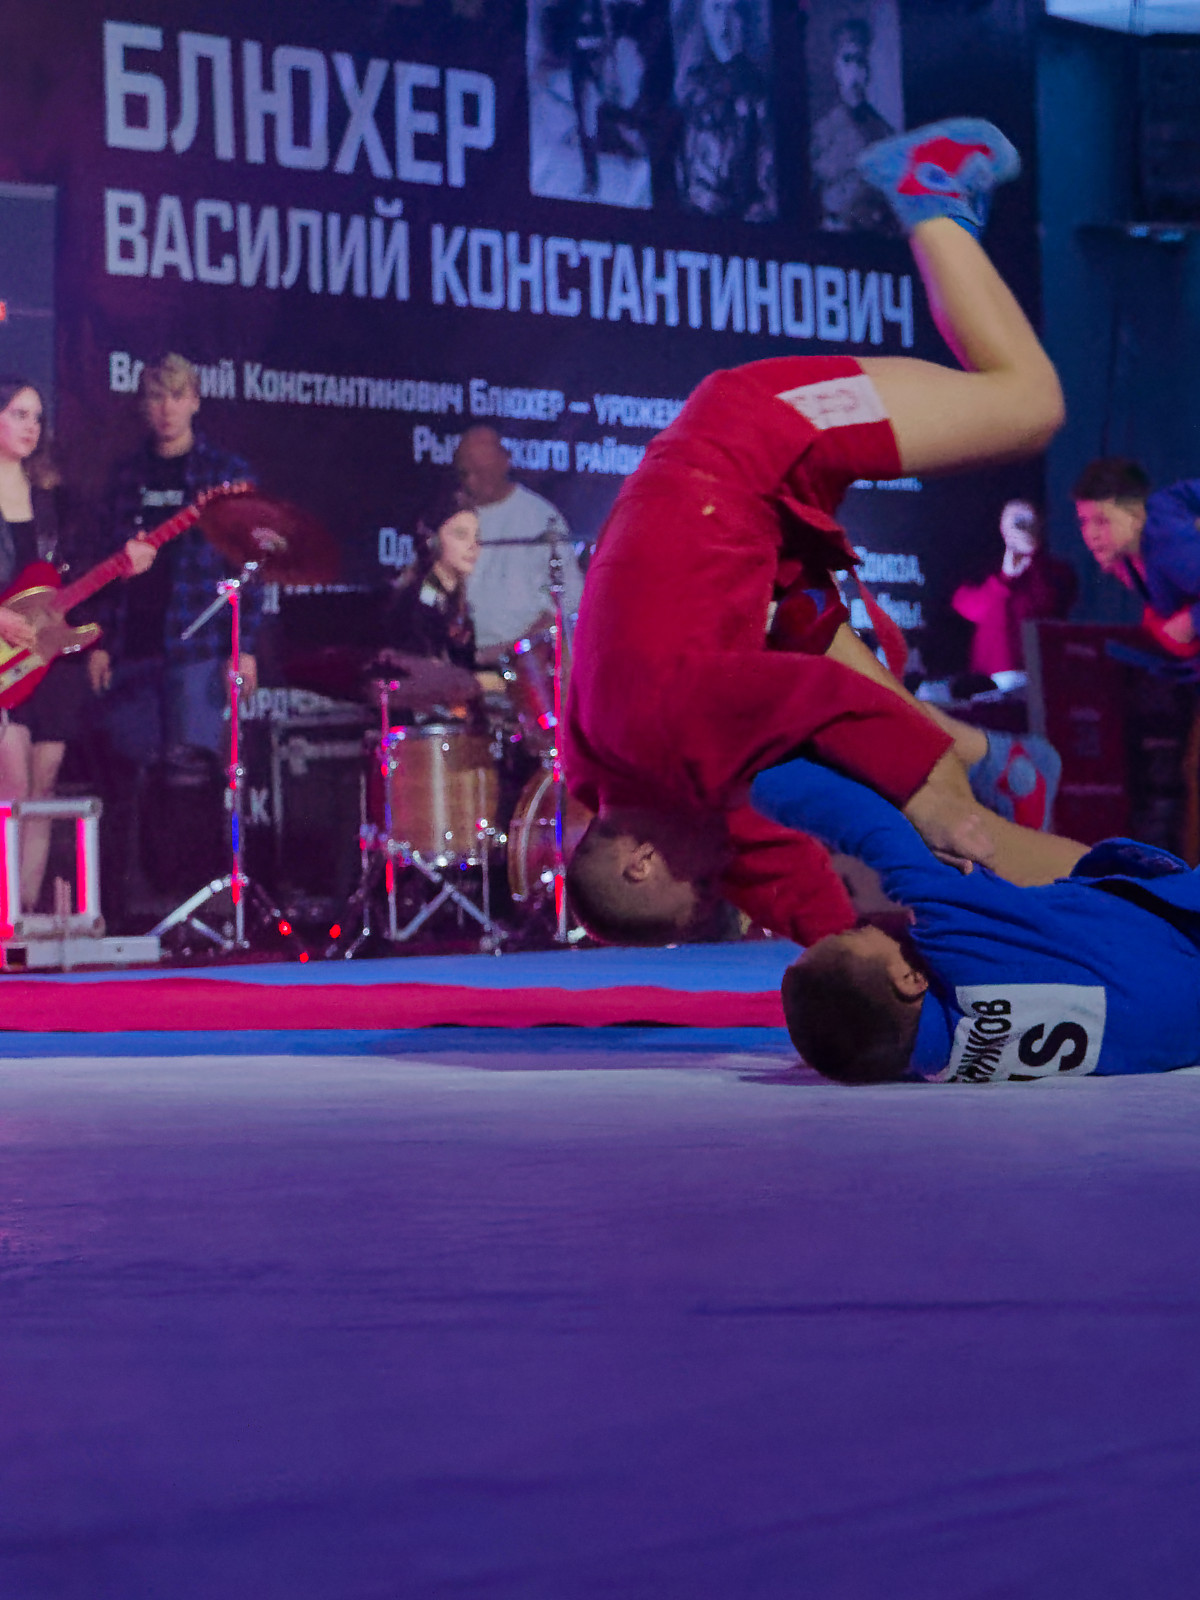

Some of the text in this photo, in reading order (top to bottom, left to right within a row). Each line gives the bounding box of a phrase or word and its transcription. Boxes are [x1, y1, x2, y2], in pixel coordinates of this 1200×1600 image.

[103, 20, 496, 188] БЛЮХЕР
[103, 188, 915, 348] ВАСИЛИЙ КОНСТАНТИНОВИЧ
